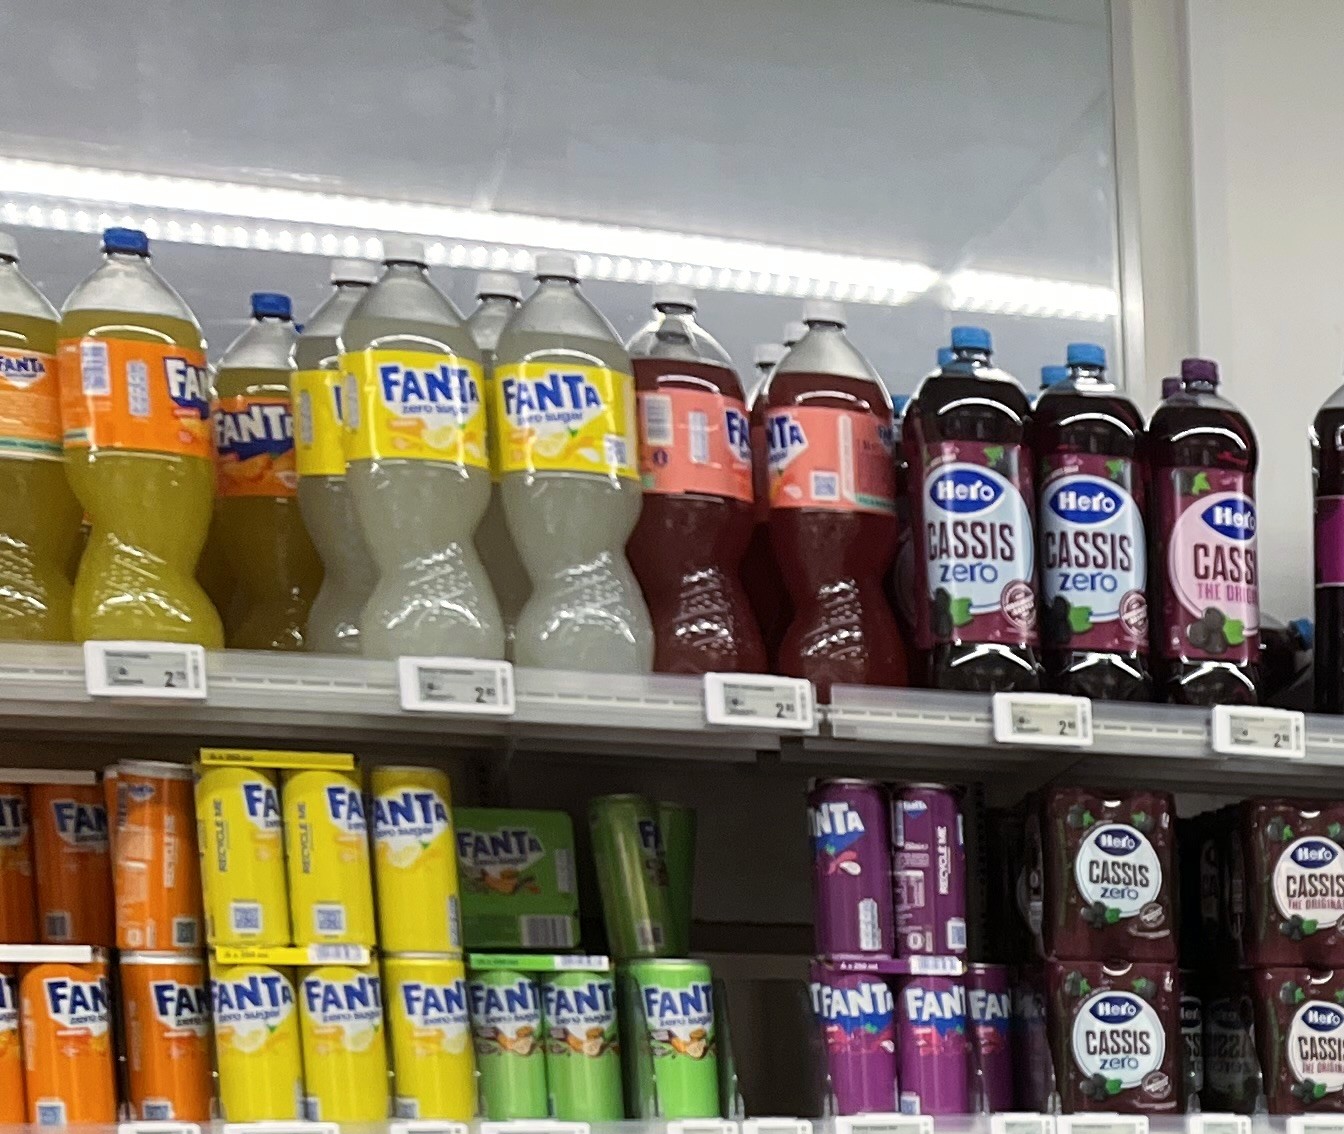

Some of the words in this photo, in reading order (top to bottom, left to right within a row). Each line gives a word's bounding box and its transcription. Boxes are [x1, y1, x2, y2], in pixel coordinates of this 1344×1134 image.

[381, 363, 480, 403] FANTA
[502, 373, 601, 416] FANTA
[937, 478, 996, 503] Hero
[1058, 489, 1116, 515] Hero
[926, 520, 1016, 562] CASSIS
[1045, 532, 1132, 573] CASSIS
[938, 558, 999, 584] zero
[1058, 569, 1118, 595] zero
[1101, 835, 1136, 850] Hero
[1297, 847, 1334, 863] Hero
[1088, 859, 1150, 888] CASSIS
[1100, 884, 1140, 901] zero
[1098, 1001, 1137, 1017] Hero
[1306, 1009, 1341, 1026] Hero
[1085, 1029, 1151, 1056] CASSIS
[1099, 1054, 1140, 1071] zero
